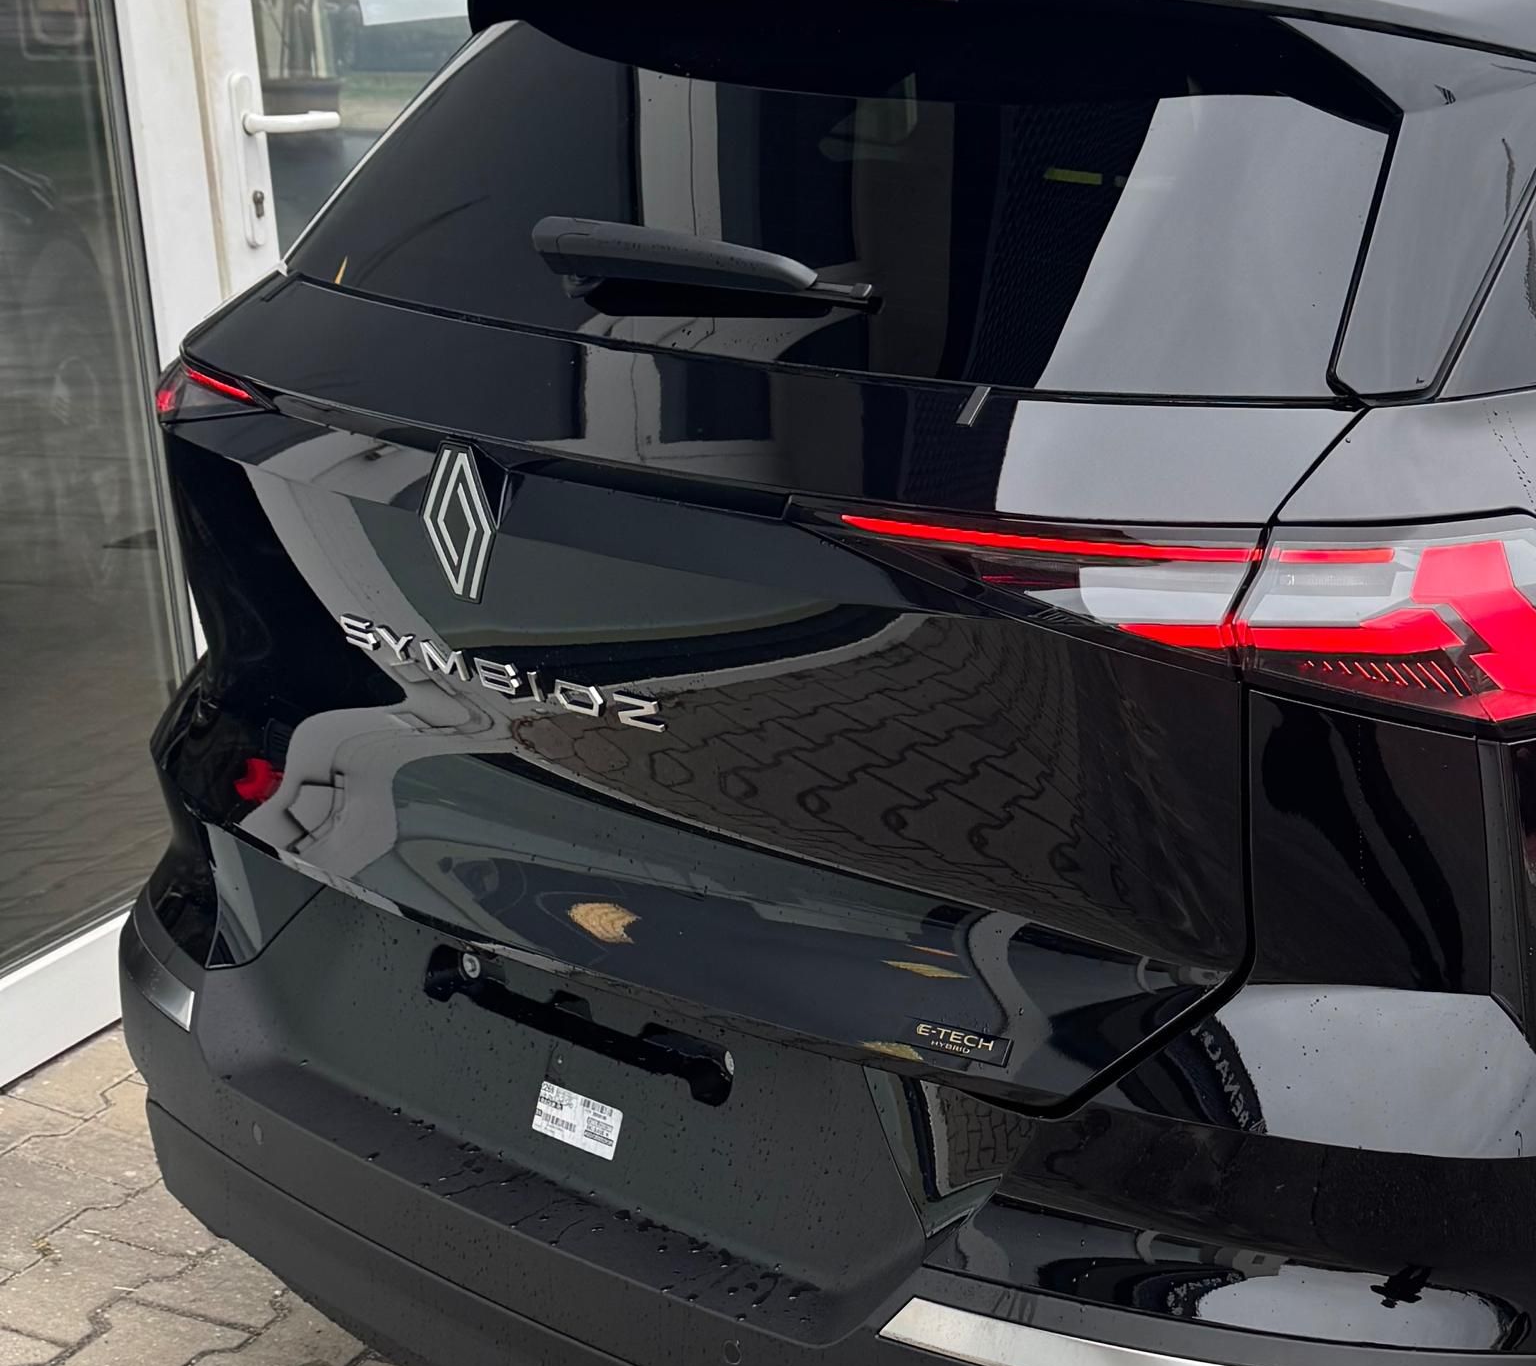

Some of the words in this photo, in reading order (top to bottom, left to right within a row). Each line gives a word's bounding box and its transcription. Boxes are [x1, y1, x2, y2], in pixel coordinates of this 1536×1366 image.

[340, 613, 667, 733] SYMBIOZ
[916, 1023, 995, 1051] E-TECH
[931, 1039, 971, 1054] HYBRID
